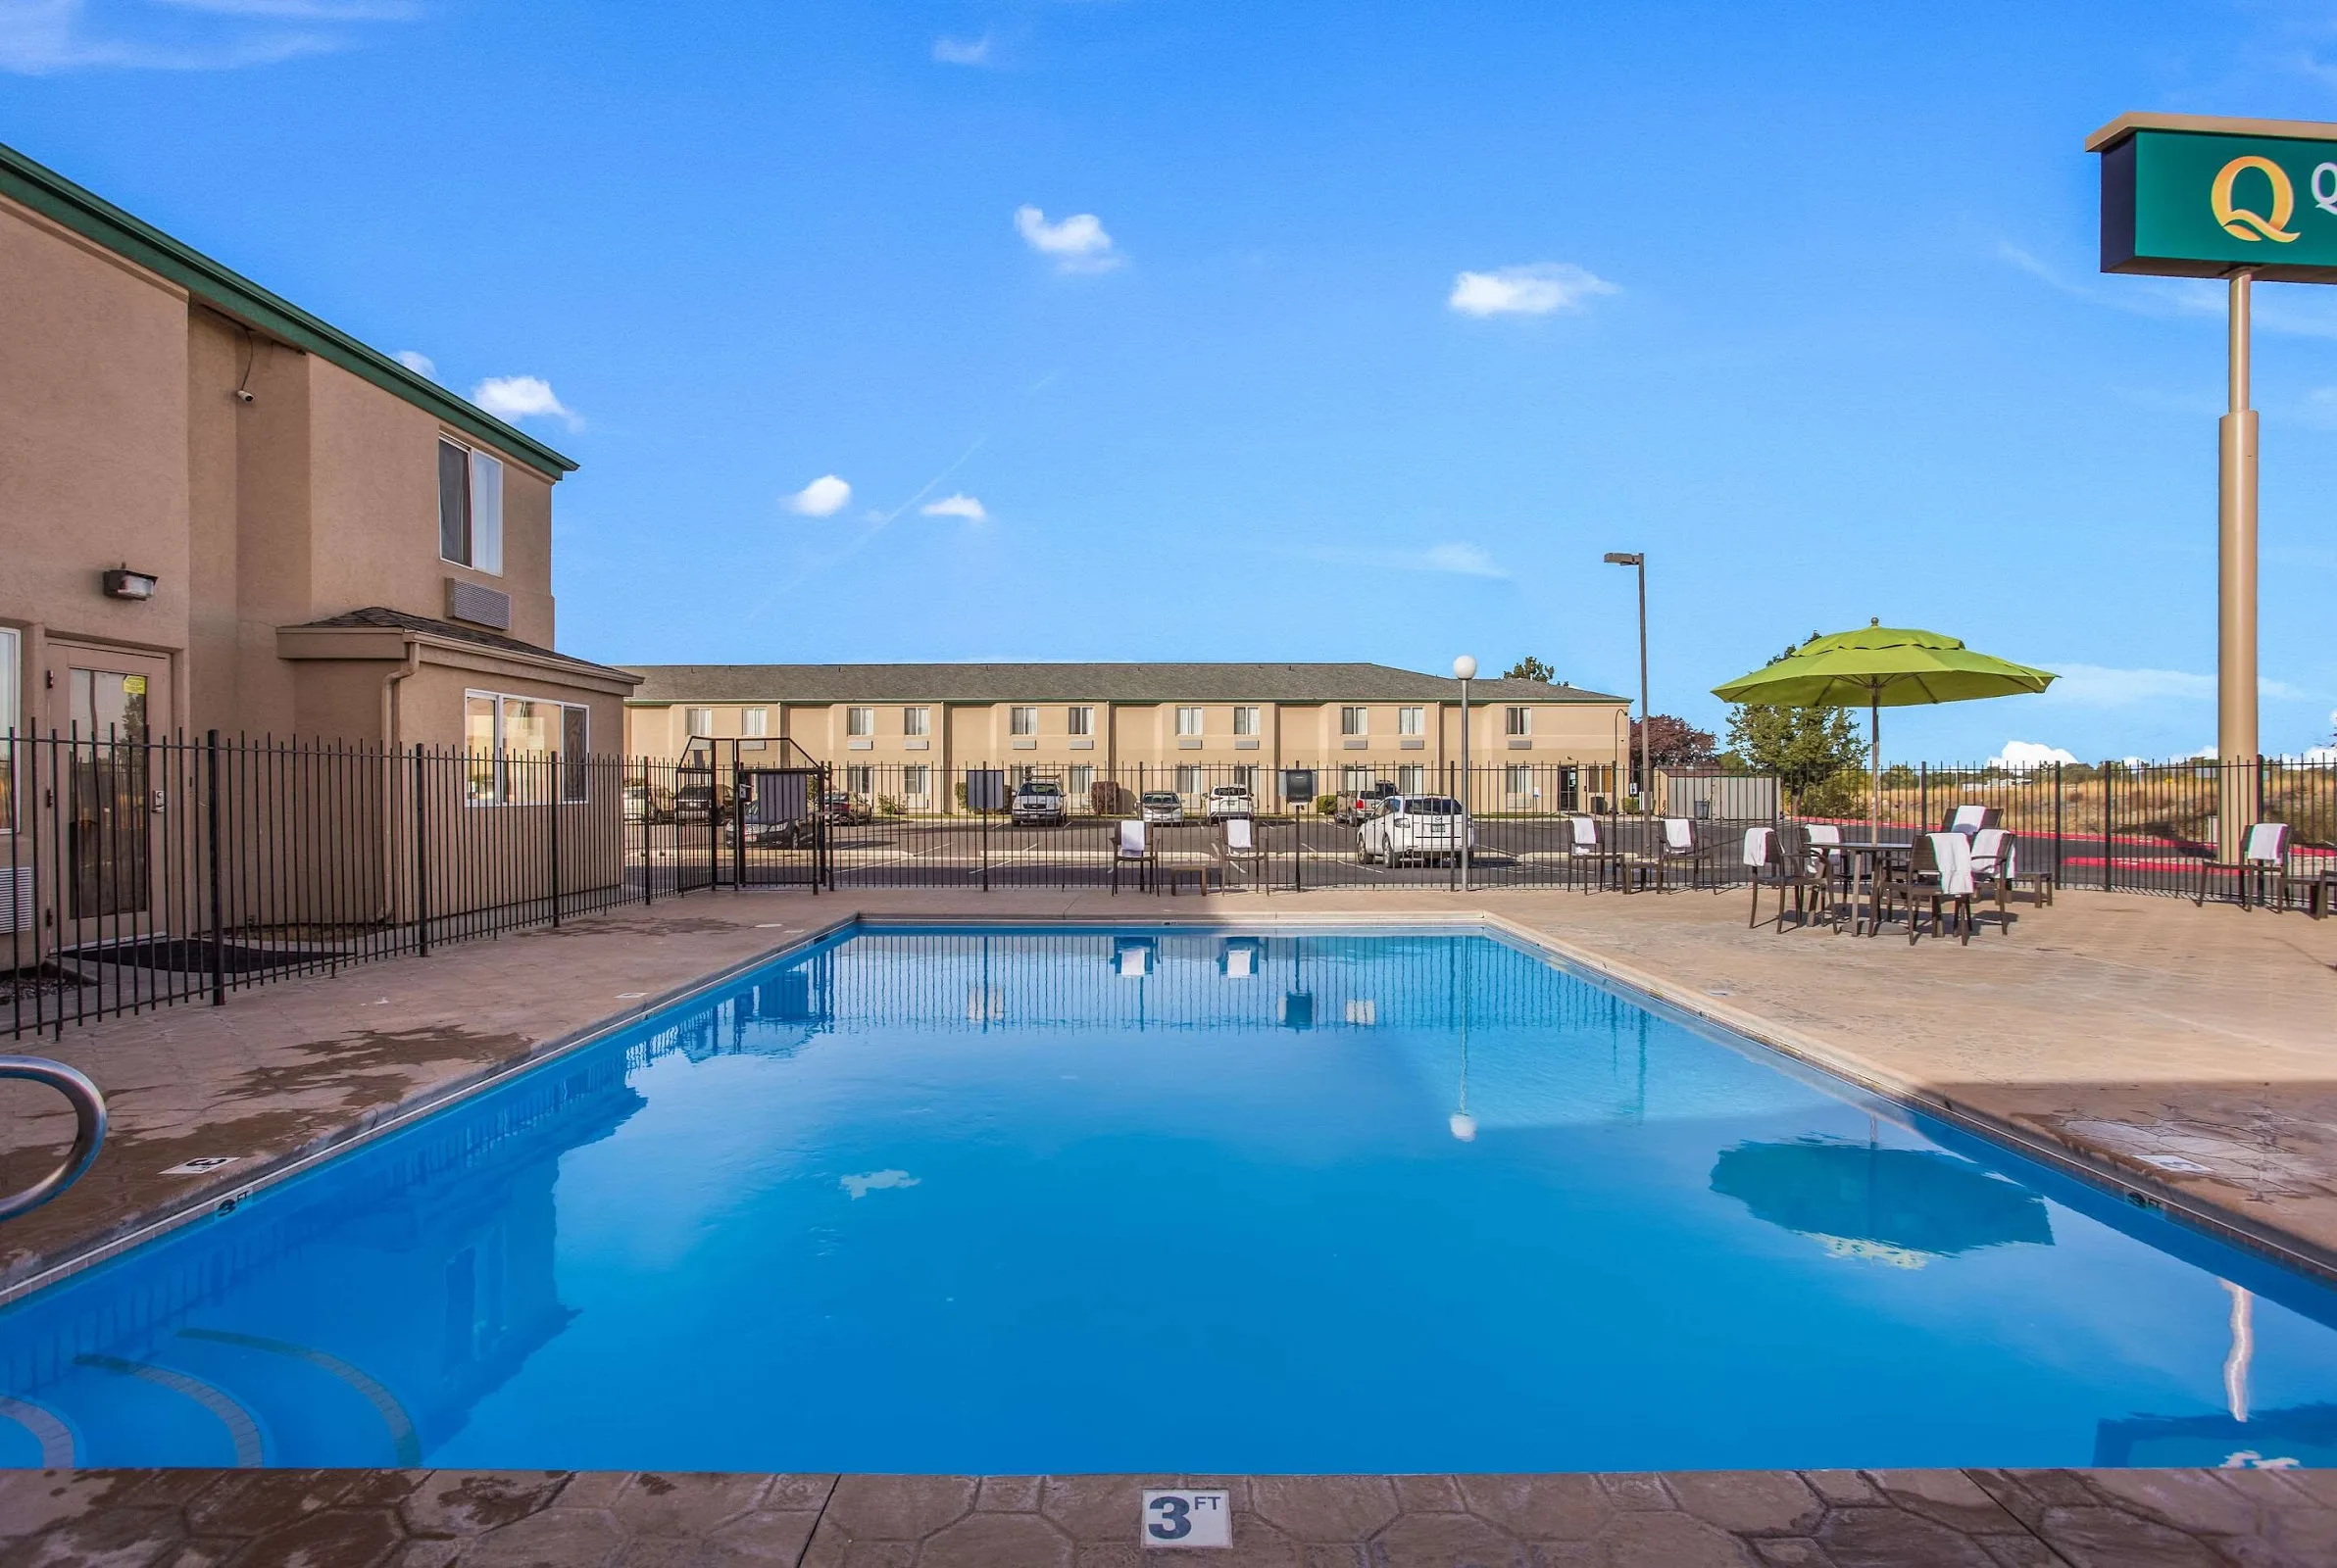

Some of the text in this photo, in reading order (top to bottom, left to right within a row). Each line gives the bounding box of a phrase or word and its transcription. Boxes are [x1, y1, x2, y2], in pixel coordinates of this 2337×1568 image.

[2211, 155, 2301, 243] Q
[1148, 1495, 1221, 1540] 3 FT
